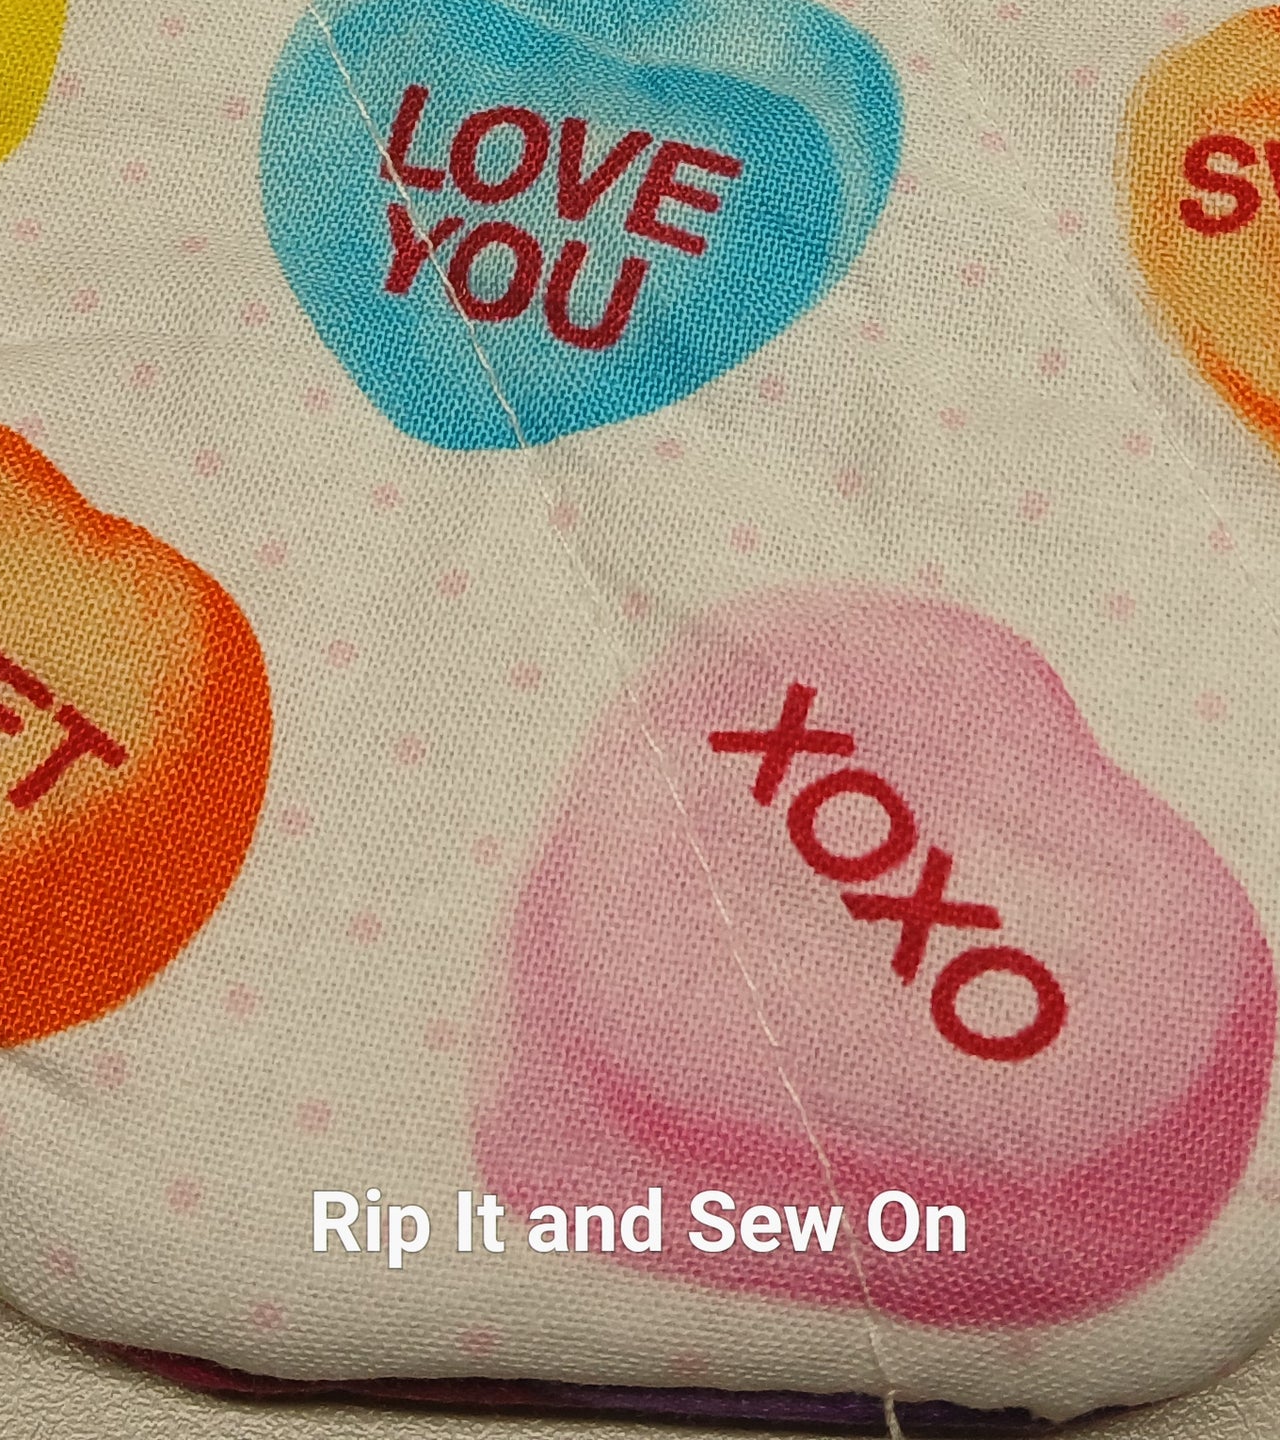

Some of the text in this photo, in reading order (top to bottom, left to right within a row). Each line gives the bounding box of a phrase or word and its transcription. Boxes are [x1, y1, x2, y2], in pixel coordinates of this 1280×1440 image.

[385, 86, 742, 256] LOVE
[382, 203, 648, 349] YOU
[706, 680, 1070, 1065] XOXO
